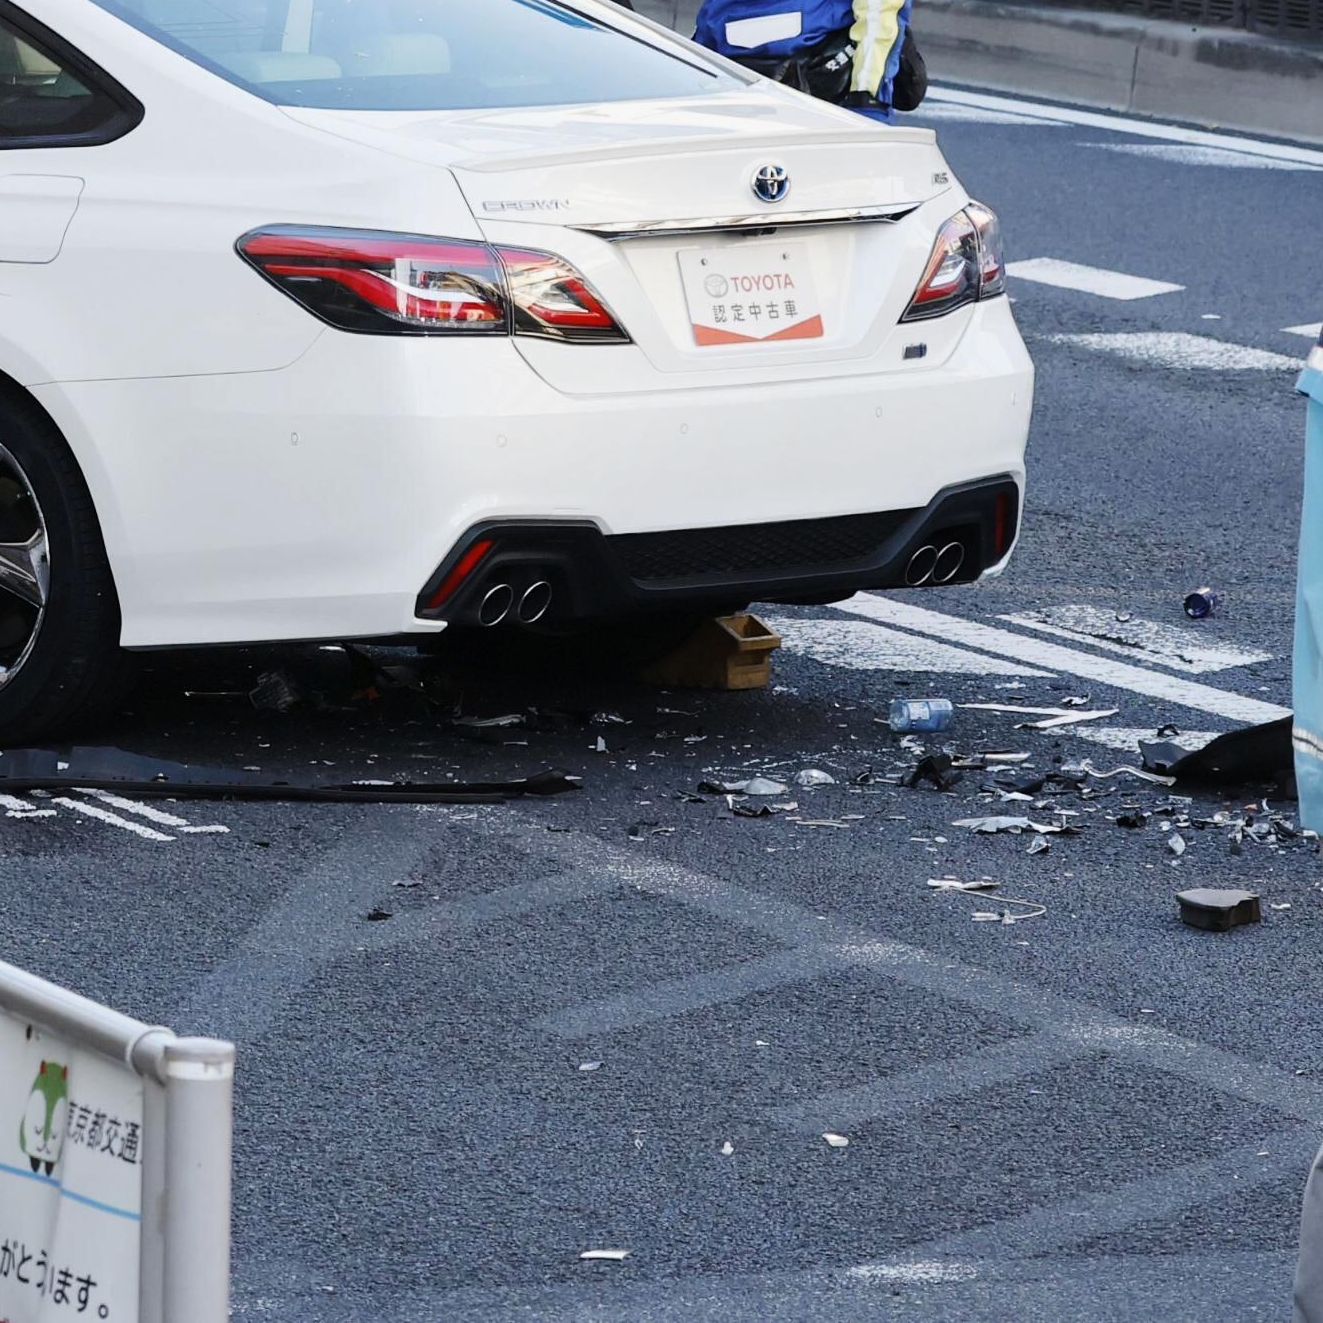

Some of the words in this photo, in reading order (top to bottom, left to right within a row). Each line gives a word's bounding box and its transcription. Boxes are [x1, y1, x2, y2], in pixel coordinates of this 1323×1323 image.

[482, 197, 570, 213] CROWN
[730, 272, 795, 293] TOYOTA
[712, 298, 799, 324] 認定中古車
